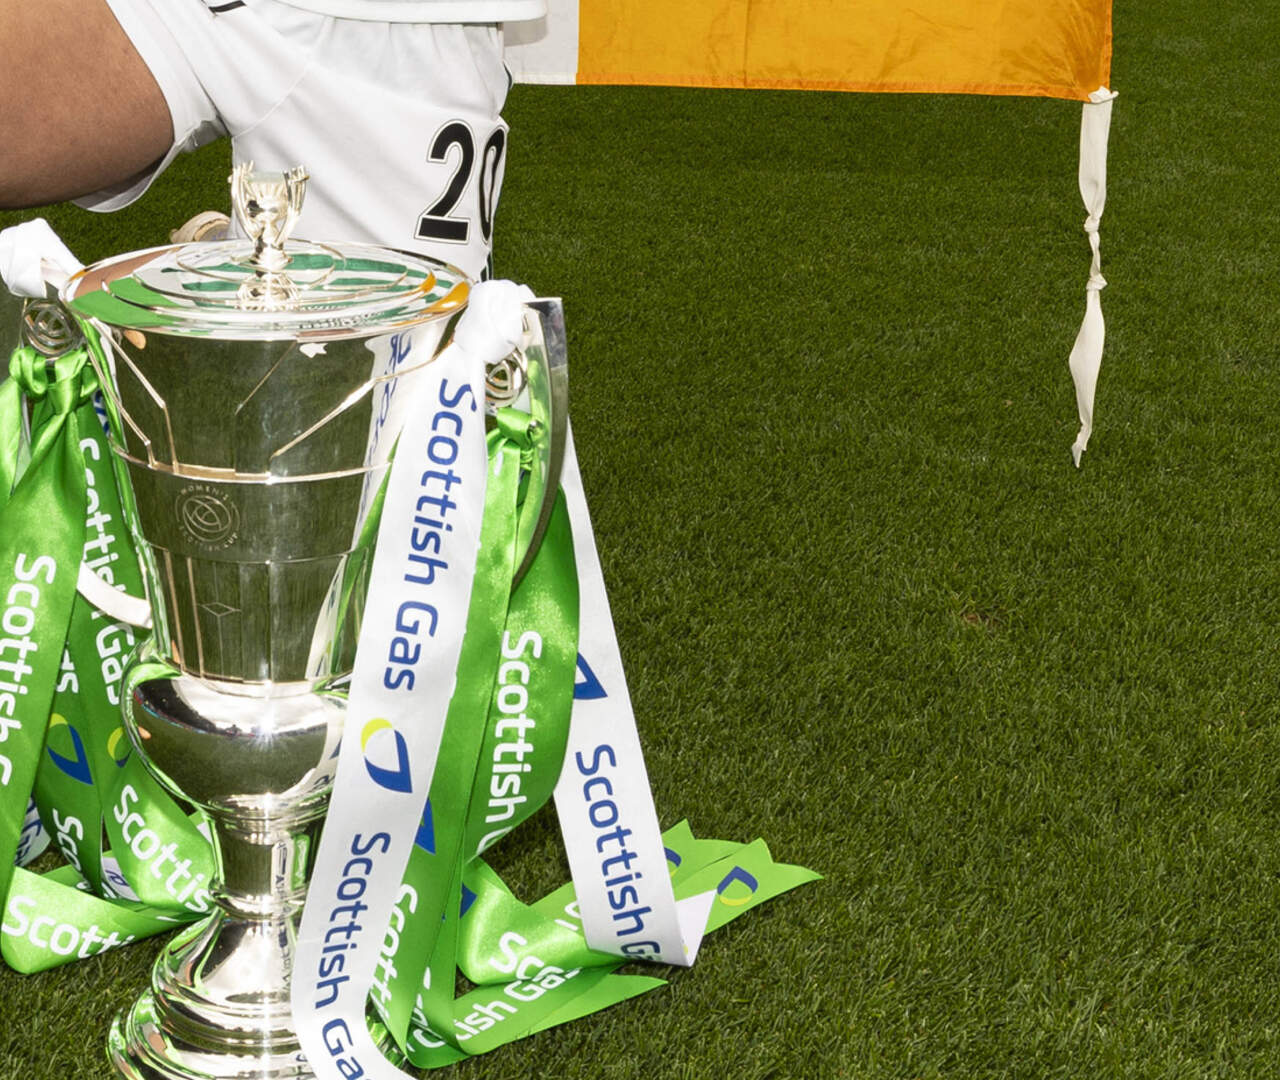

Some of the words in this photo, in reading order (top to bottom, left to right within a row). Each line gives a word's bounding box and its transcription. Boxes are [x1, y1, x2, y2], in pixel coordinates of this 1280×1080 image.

[417, 121, 506, 242] 20
[403, 378, 478, 585] Scottish
[383, 600, 439, 691] Gas
[485, 630, 543, 823] Scottish
[315, 832, 391, 1009] Scottish
[575, 744, 652, 937] Scottish
[322, 1018, 369, 1080] Ga
